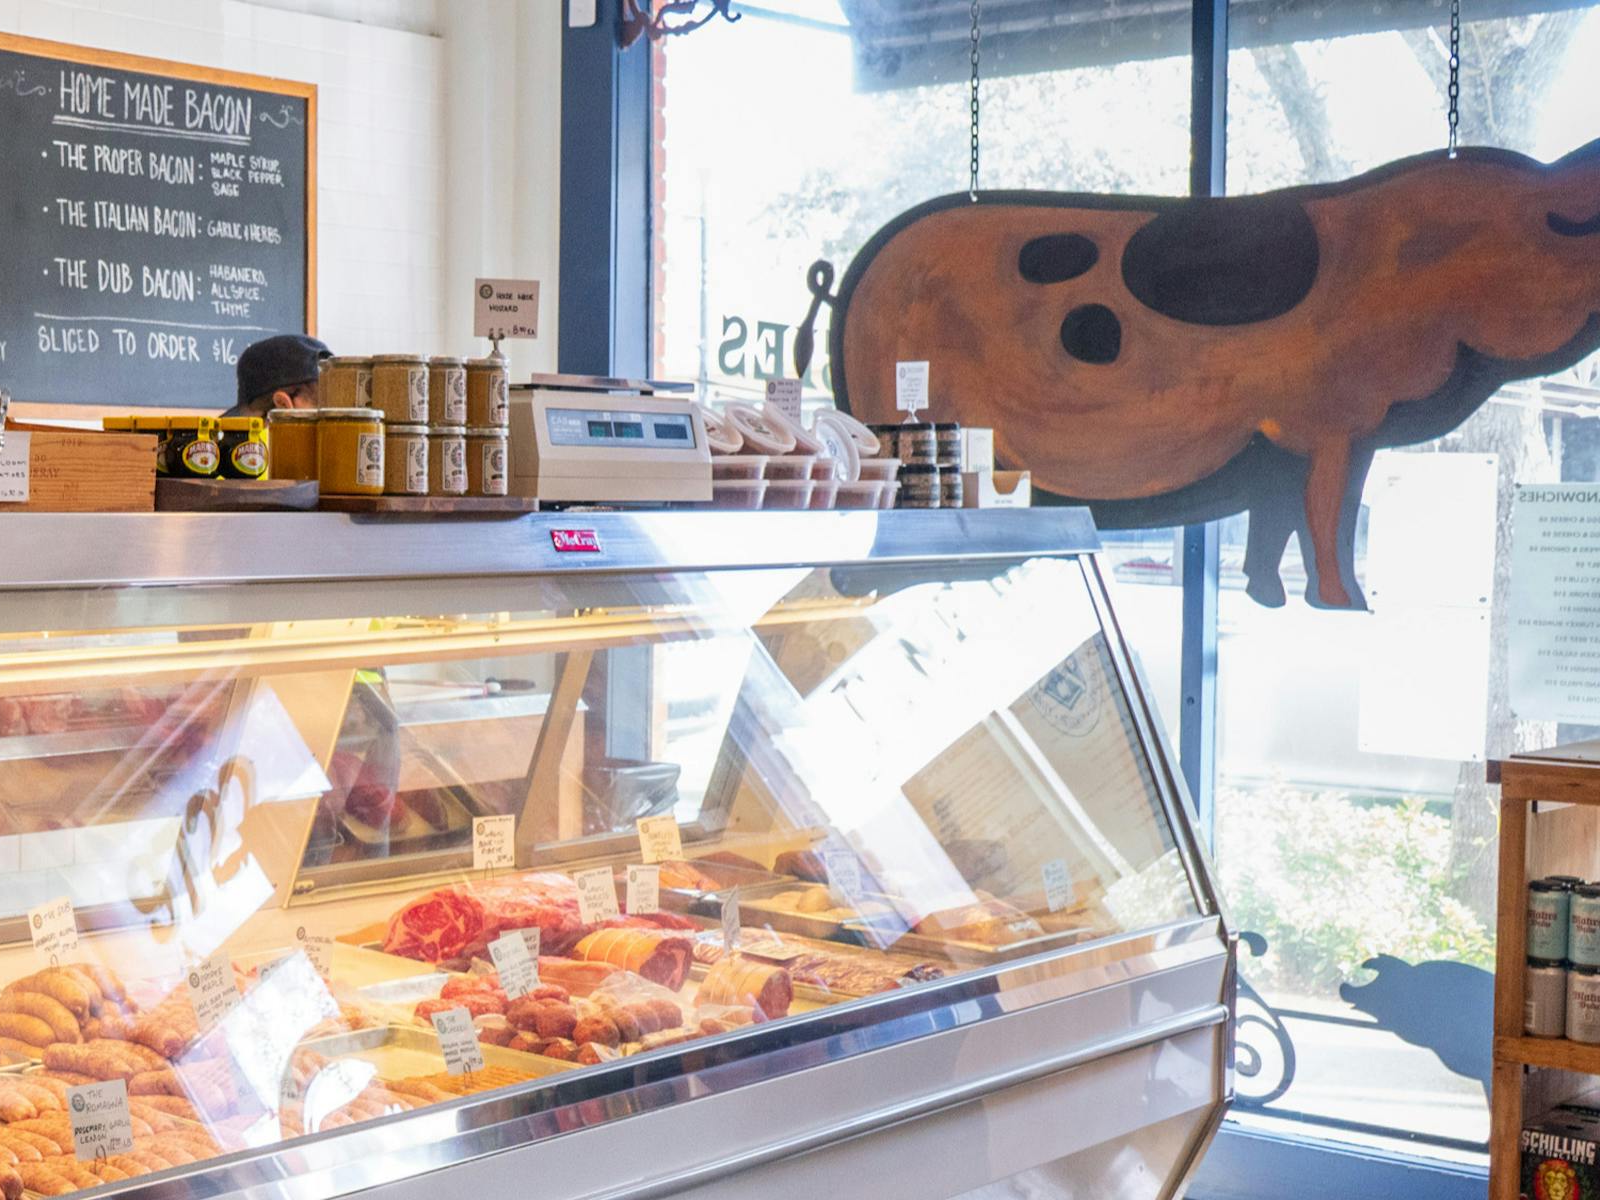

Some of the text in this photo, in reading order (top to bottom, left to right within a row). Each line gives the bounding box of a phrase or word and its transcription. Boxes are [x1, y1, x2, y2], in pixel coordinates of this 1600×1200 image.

[60, 70, 252, 135] HOME MADE BACON
[53, 140, 88, 171] THE
[93, 144, 145, 176] PROPER
[210, 152, 245, 169] MAPLE
[211, 167, 243, 182] BLACK
[212, 181, 240, 197] SAGE
[57, 198, 88, 228] THE
[94, 201, 149, 233] ITALIAN
[207, 220, 282, 245] GARLIC HERBS
[54, 257, 88, 289] THE
[98, 259, 134, 294] DUB
[211, 301, 251, 318] THYME
[38, 326, 100, 353] SLICED
[112, 328, 136, 355] TO
[148, 332, 200, 362] ORDER
[1521, 1130, 1596, 1159] SCHILLING
